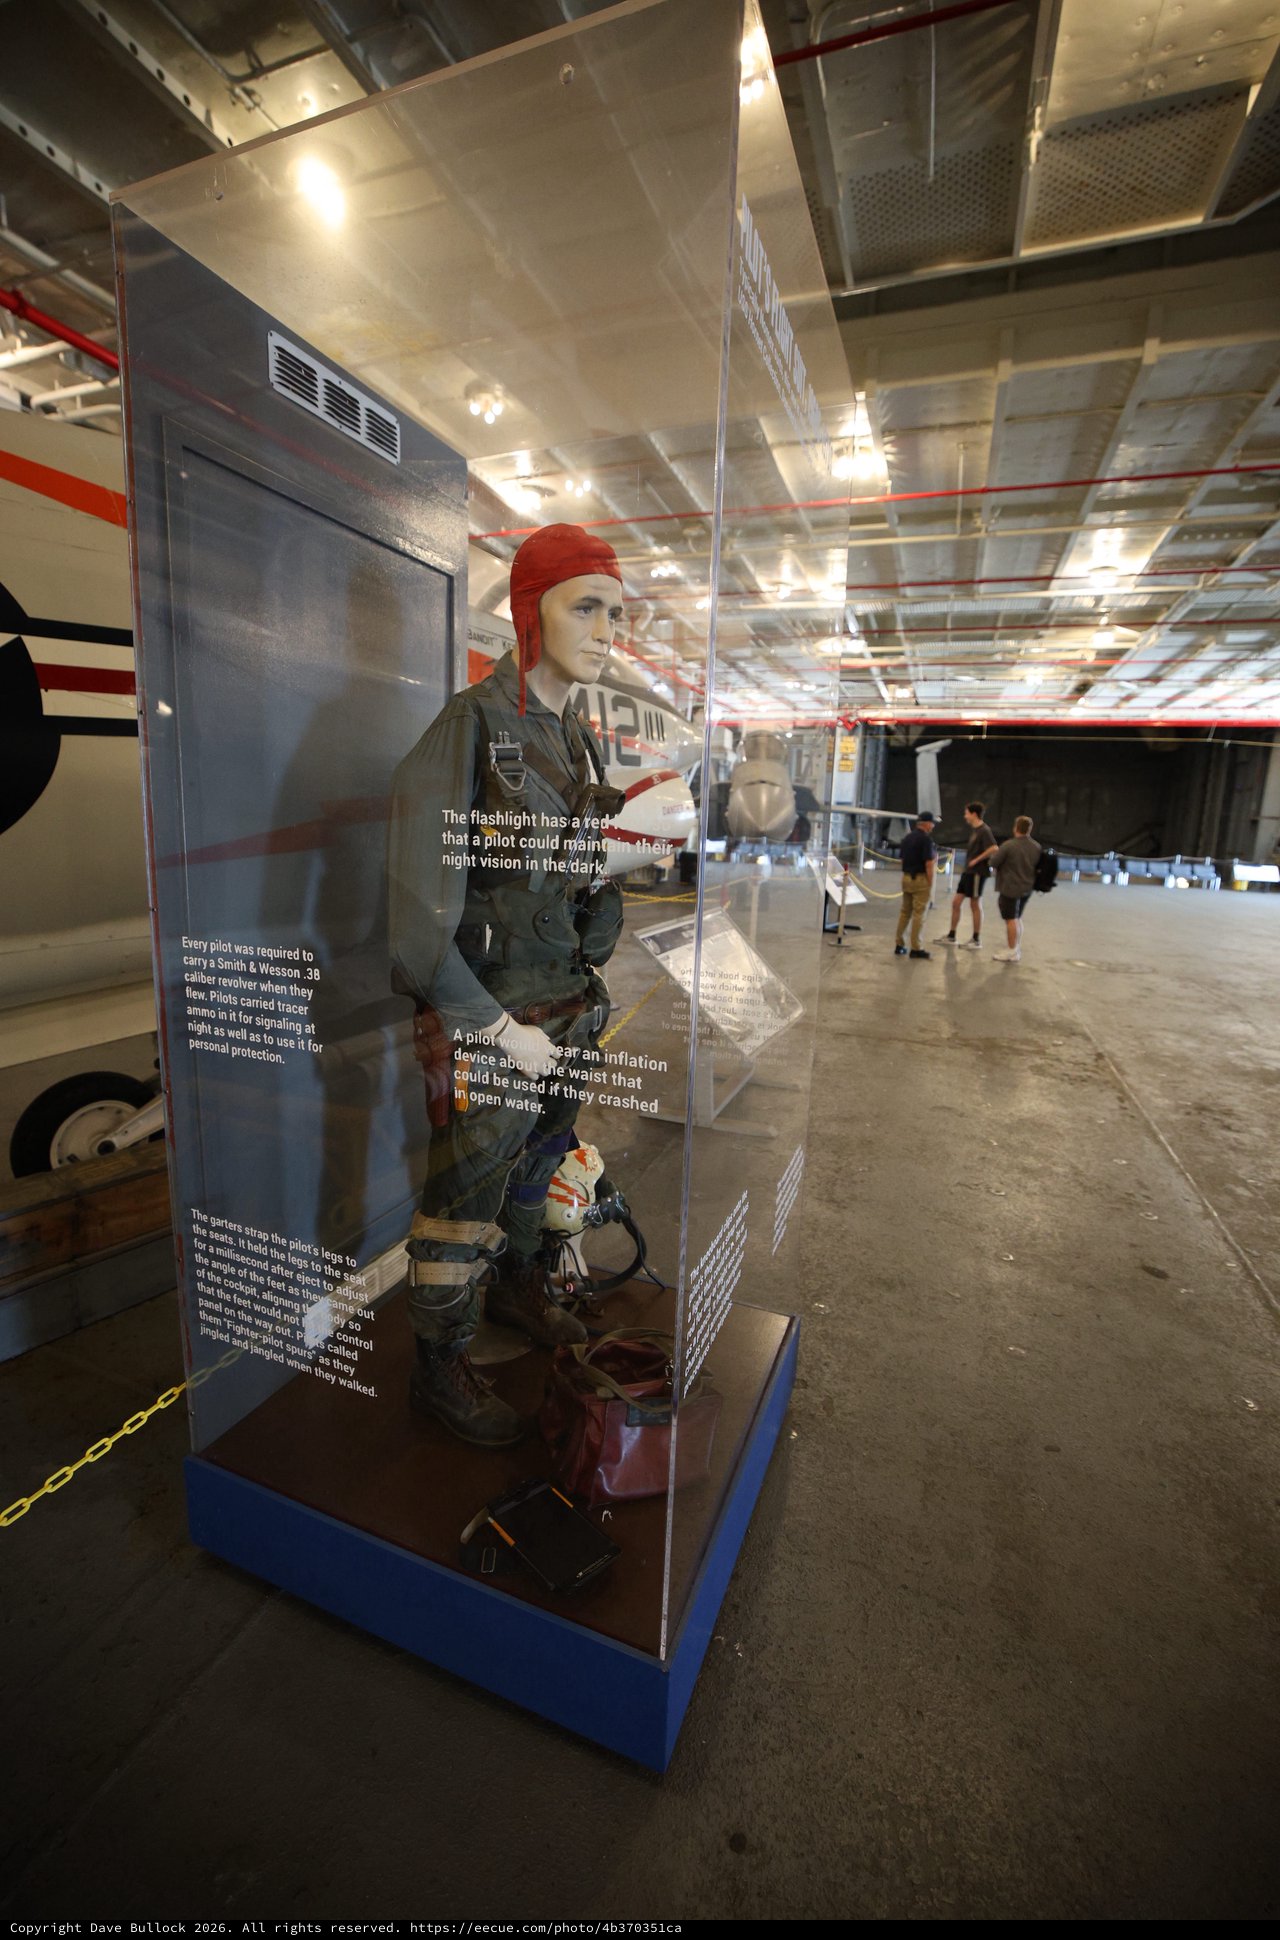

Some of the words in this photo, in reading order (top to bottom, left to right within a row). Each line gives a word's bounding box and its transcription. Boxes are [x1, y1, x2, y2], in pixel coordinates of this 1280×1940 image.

[442, 809, 467, 824] The
[470, 810, 536, 832] flashlight
[541, 812, 567, 829] has
[569, 817, 581, 831] a
[584, 813, 609, 832] red
[442, 830, 469, 848] that
[473, 835, 480, 846] a
[484, 831, 515, 850] pilot
[519, 835, 559, 850] could
[635, 838, 674, 857] their
[443, 851, 476, 871] night
[480, 853, 521, 869] vision
[526, 855, 538, 871] in
[543, 857, 566, 873] the
[182, 936, 207, 952] Every
[210, 939, 232, 953] pilot
[234, 945, 254, 955] was
[257, 946, 299, 960] required
[303, 950, 313, 962] to
[183, 956, 207, 969] carry
[210, 959, 215, 968] a
[218, 958, 246, 971] Smith
[249, 961, 256, 973] &
[259, 962, 300, 978] Wesson
[304, 968, 320, 980] .38
[185, 971, 215, 984] caliber
[218, 977, 257, 990] revolver
[260, 980, 287, 995] when
[289, 984, 313, 1001] they
[186, 986, 207, 1000] flew.
[210, 991, 237, 1005] Pilots
[240, 997, 274, 1010] carried
[277, 1001, 308, 1015] tracer
[187, 1006, 216, 1018] ammo
[218, 1008, 227, 1020] in
[230, 1009, 236, 1022] it
[239, 1011, 253, 1024] for
[255, 1014, 302, 1035] signaling
[305, 1023, 315, 1034] at
[188, 1020, 211, 1035] night
[214, 1027, 225, 1036] as
[227, 1028, 247, 1040] well
[249, 1033, 261, 1042] as
[263, 1033, 273, 1044] to
[277, 1037, 295, 1048] use
[298, 1037, 305, 1050] it
[308, 1039, 323, 1053] for
[189, 1039, 229, 1053] personal
[232, 1047, 285, 1064] protection.
[453, 1028, 463, 1041] A
[466, 1030, 496, 1046] pilot
[582, 1050, 599, 1061] an
[605, 1049, 667, 1072] inflation
[454, 1048, 496, 1066] device
[499, 1055, 538, 1074] about
[542, 1060, 565, 1077] the
[568, 1066, 607, 1084] waist
[612, 1072, 642, 1089] that
[454, 1070, 489, 1084] could
[493, 1073, 509, 1088] be
[513, 1078, 545, 1095] used
[549, 1082, 559, 1096] if
[563, 1085, 594, 1105] they
[599, 1094, 659, 1116] crashed
[454, 1087, 467, 1099] in
[470, 1092, 501, 1106] open
[505, 1098, 545, 1115] water.
[191, 1208, 208, 1222] The
[210, 1217, 242, 1232] garters
[245, 1227, 269, 1242] strap
[271, 1233, 287, 1246] the
[289, 1238, 319, 1256] pilot's
[322, 1247, 343, 1264] legs
[345, 1256, 356, 1267] to
[192, 1224, 207, 1236] the
[209, 1231, 236, 1246] seats.
[239, 1238, 245, 1249] It
[247, 1240, 267, 1255] held
[270, 1248, 286, 1261] the
[288, 1252, 308, 1269] legs
[311, 1261, 321, 1272] to
[324, 1265, 341, 1278] the
[343, 1273, 367, 1286] seat
[194, 1238, 206, 1250] for
[209, 1245, 214, 1253] a
[216, 1247, 268, 1271] millisecond
[271, 1264, 294, 1279] after
[297, 1272, 320, 1287] eject
[323, 1280, 333, 1291] to
[336, 1286, 369, 1304] adjust
[195, 1253, 209, 1266] the
[211, 1261, 236, 1274] angle
[238, 1268, 247, 1278] of
[249, 1271, 264, 1284] the
[267, 1276, 286, 1291] feet
[288, 1286, 299, 1296] as
[328, 1297, 354, 1314] came
[357, 1308, 375, 1321] out
[196, 1269, 205, 1278] of
[207, 1271, 221, 1284] the
[224, 1279, 259, 1298] cockpit,
[262, 1291, 300, 1313] aligning
[349, 1321, 361, 1331] so
[197, 1282, 214, 1296] that
[217, 1289, 231, 1301] the
[233, 1294, 251, 1309] feet
[253, 1303, 281, 1319] would
[284, 1312, 299, 1326] not
[337, 1327, 373, 1351] control
[199, 1298, 222, 1312] panel
[224, 1307, 235, 1317] on
[237, 1310, 252, 1323] the
[255, 1318, 273, 1332] way
[275, 1326, 293, 1338] out.
[328, 1344, 358, 1361] called
[199, 1310, 221, 1326] them
[286, 1344, 316, 1359] spurs"
[319, 1356, 330, 1366] as
[333, 1359, 355, 1376] they
[201, 1323, 229, 1342] jingled
[232, 1333, 248, 1349] and
[250, 1342, 284, 1363] jangled
[286, 1354, 312, 1374] when
[314, 1367, 336, 1384] they
[339, 1375, 377, 1397] walked.
